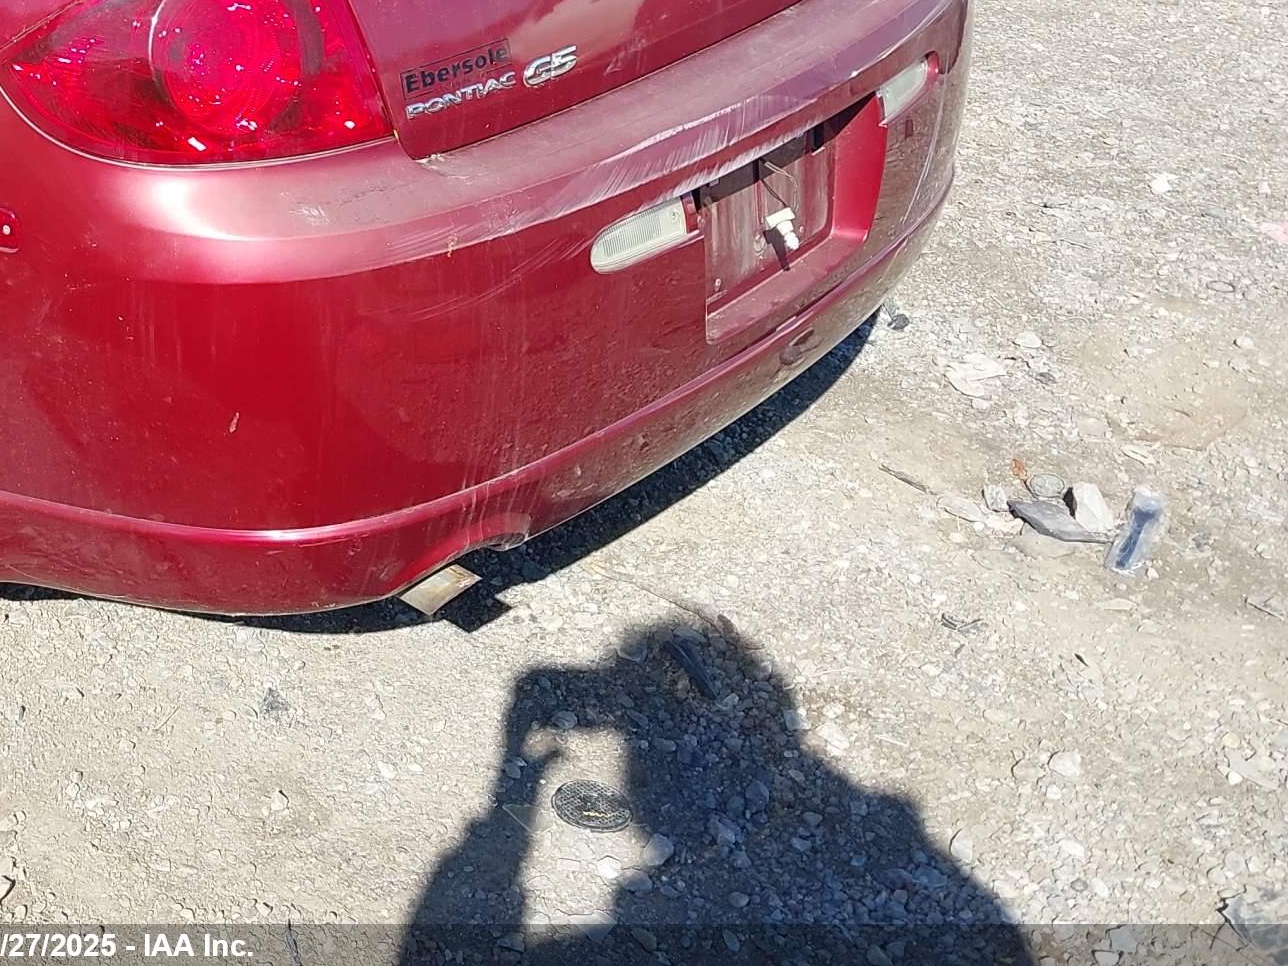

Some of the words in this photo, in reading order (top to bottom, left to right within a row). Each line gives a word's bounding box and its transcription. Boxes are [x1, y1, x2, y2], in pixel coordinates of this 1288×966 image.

[404, 47, 509, 93] Ebersole
[406, 71, 516, 119] PONTIAC
[523, 45, 577, 87] G5
